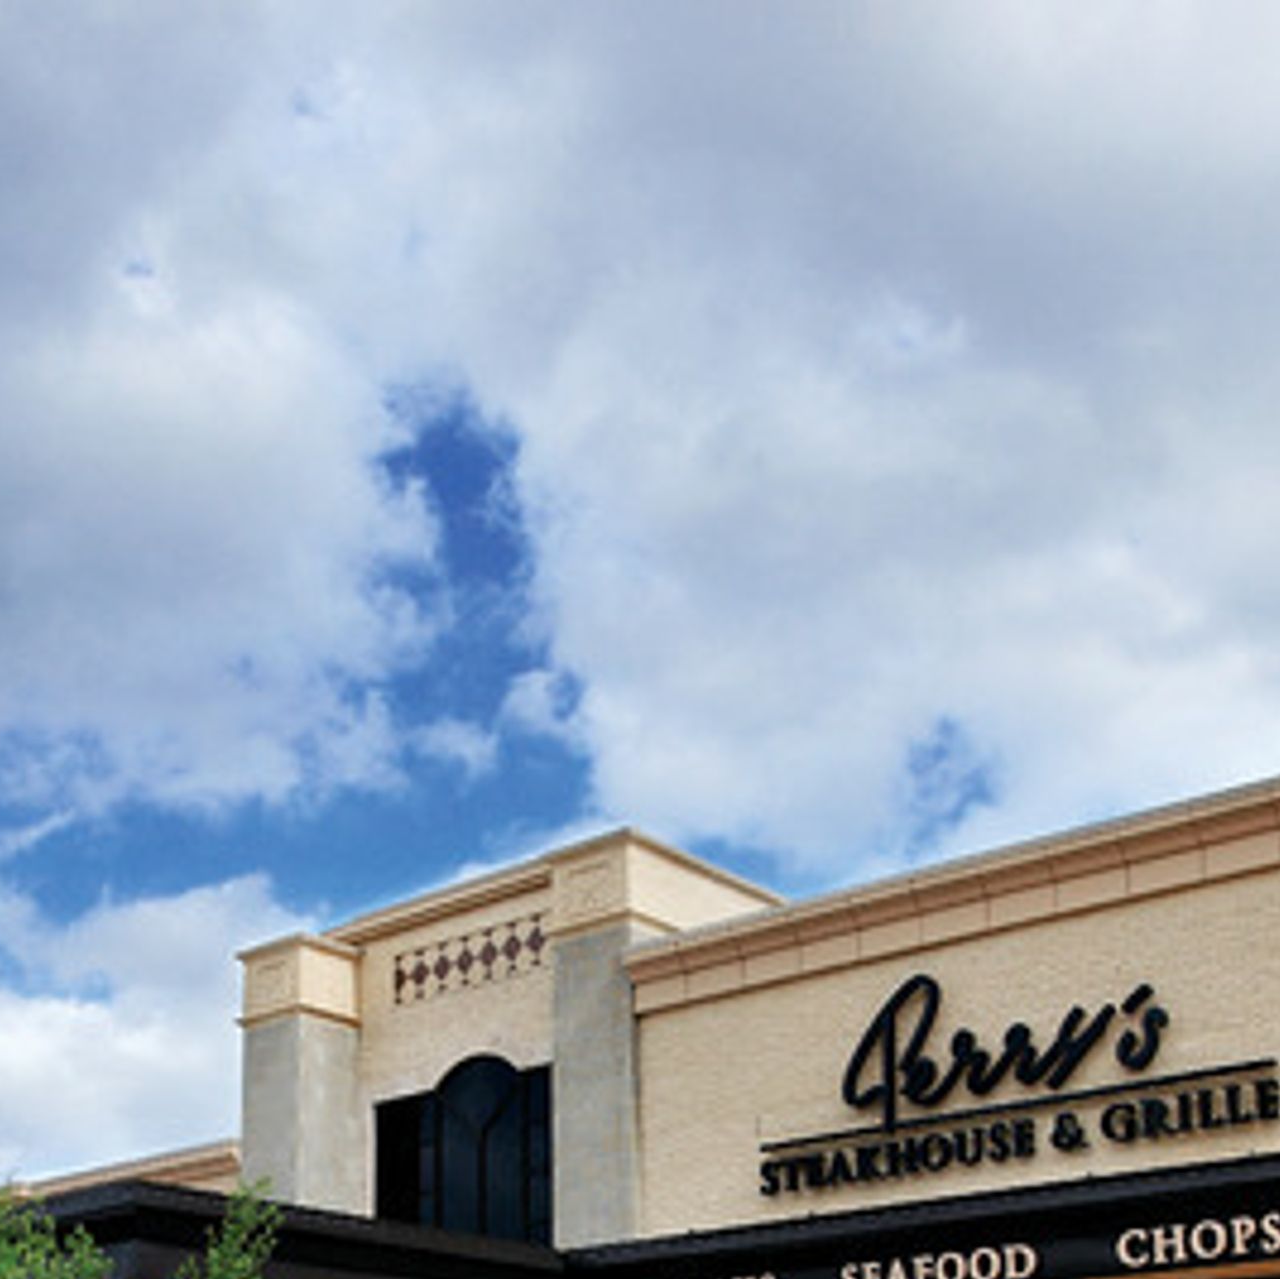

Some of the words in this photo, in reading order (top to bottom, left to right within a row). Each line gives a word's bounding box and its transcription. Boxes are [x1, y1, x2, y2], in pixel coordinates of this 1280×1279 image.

[842, 974, 1170, 1133] Perry's
[759, 1118, 1037, 1197] STEAKHOUSE
[1051, 1111, 1090, 1152] &
[1100, 1077, 1280, 1143] GRILLE
